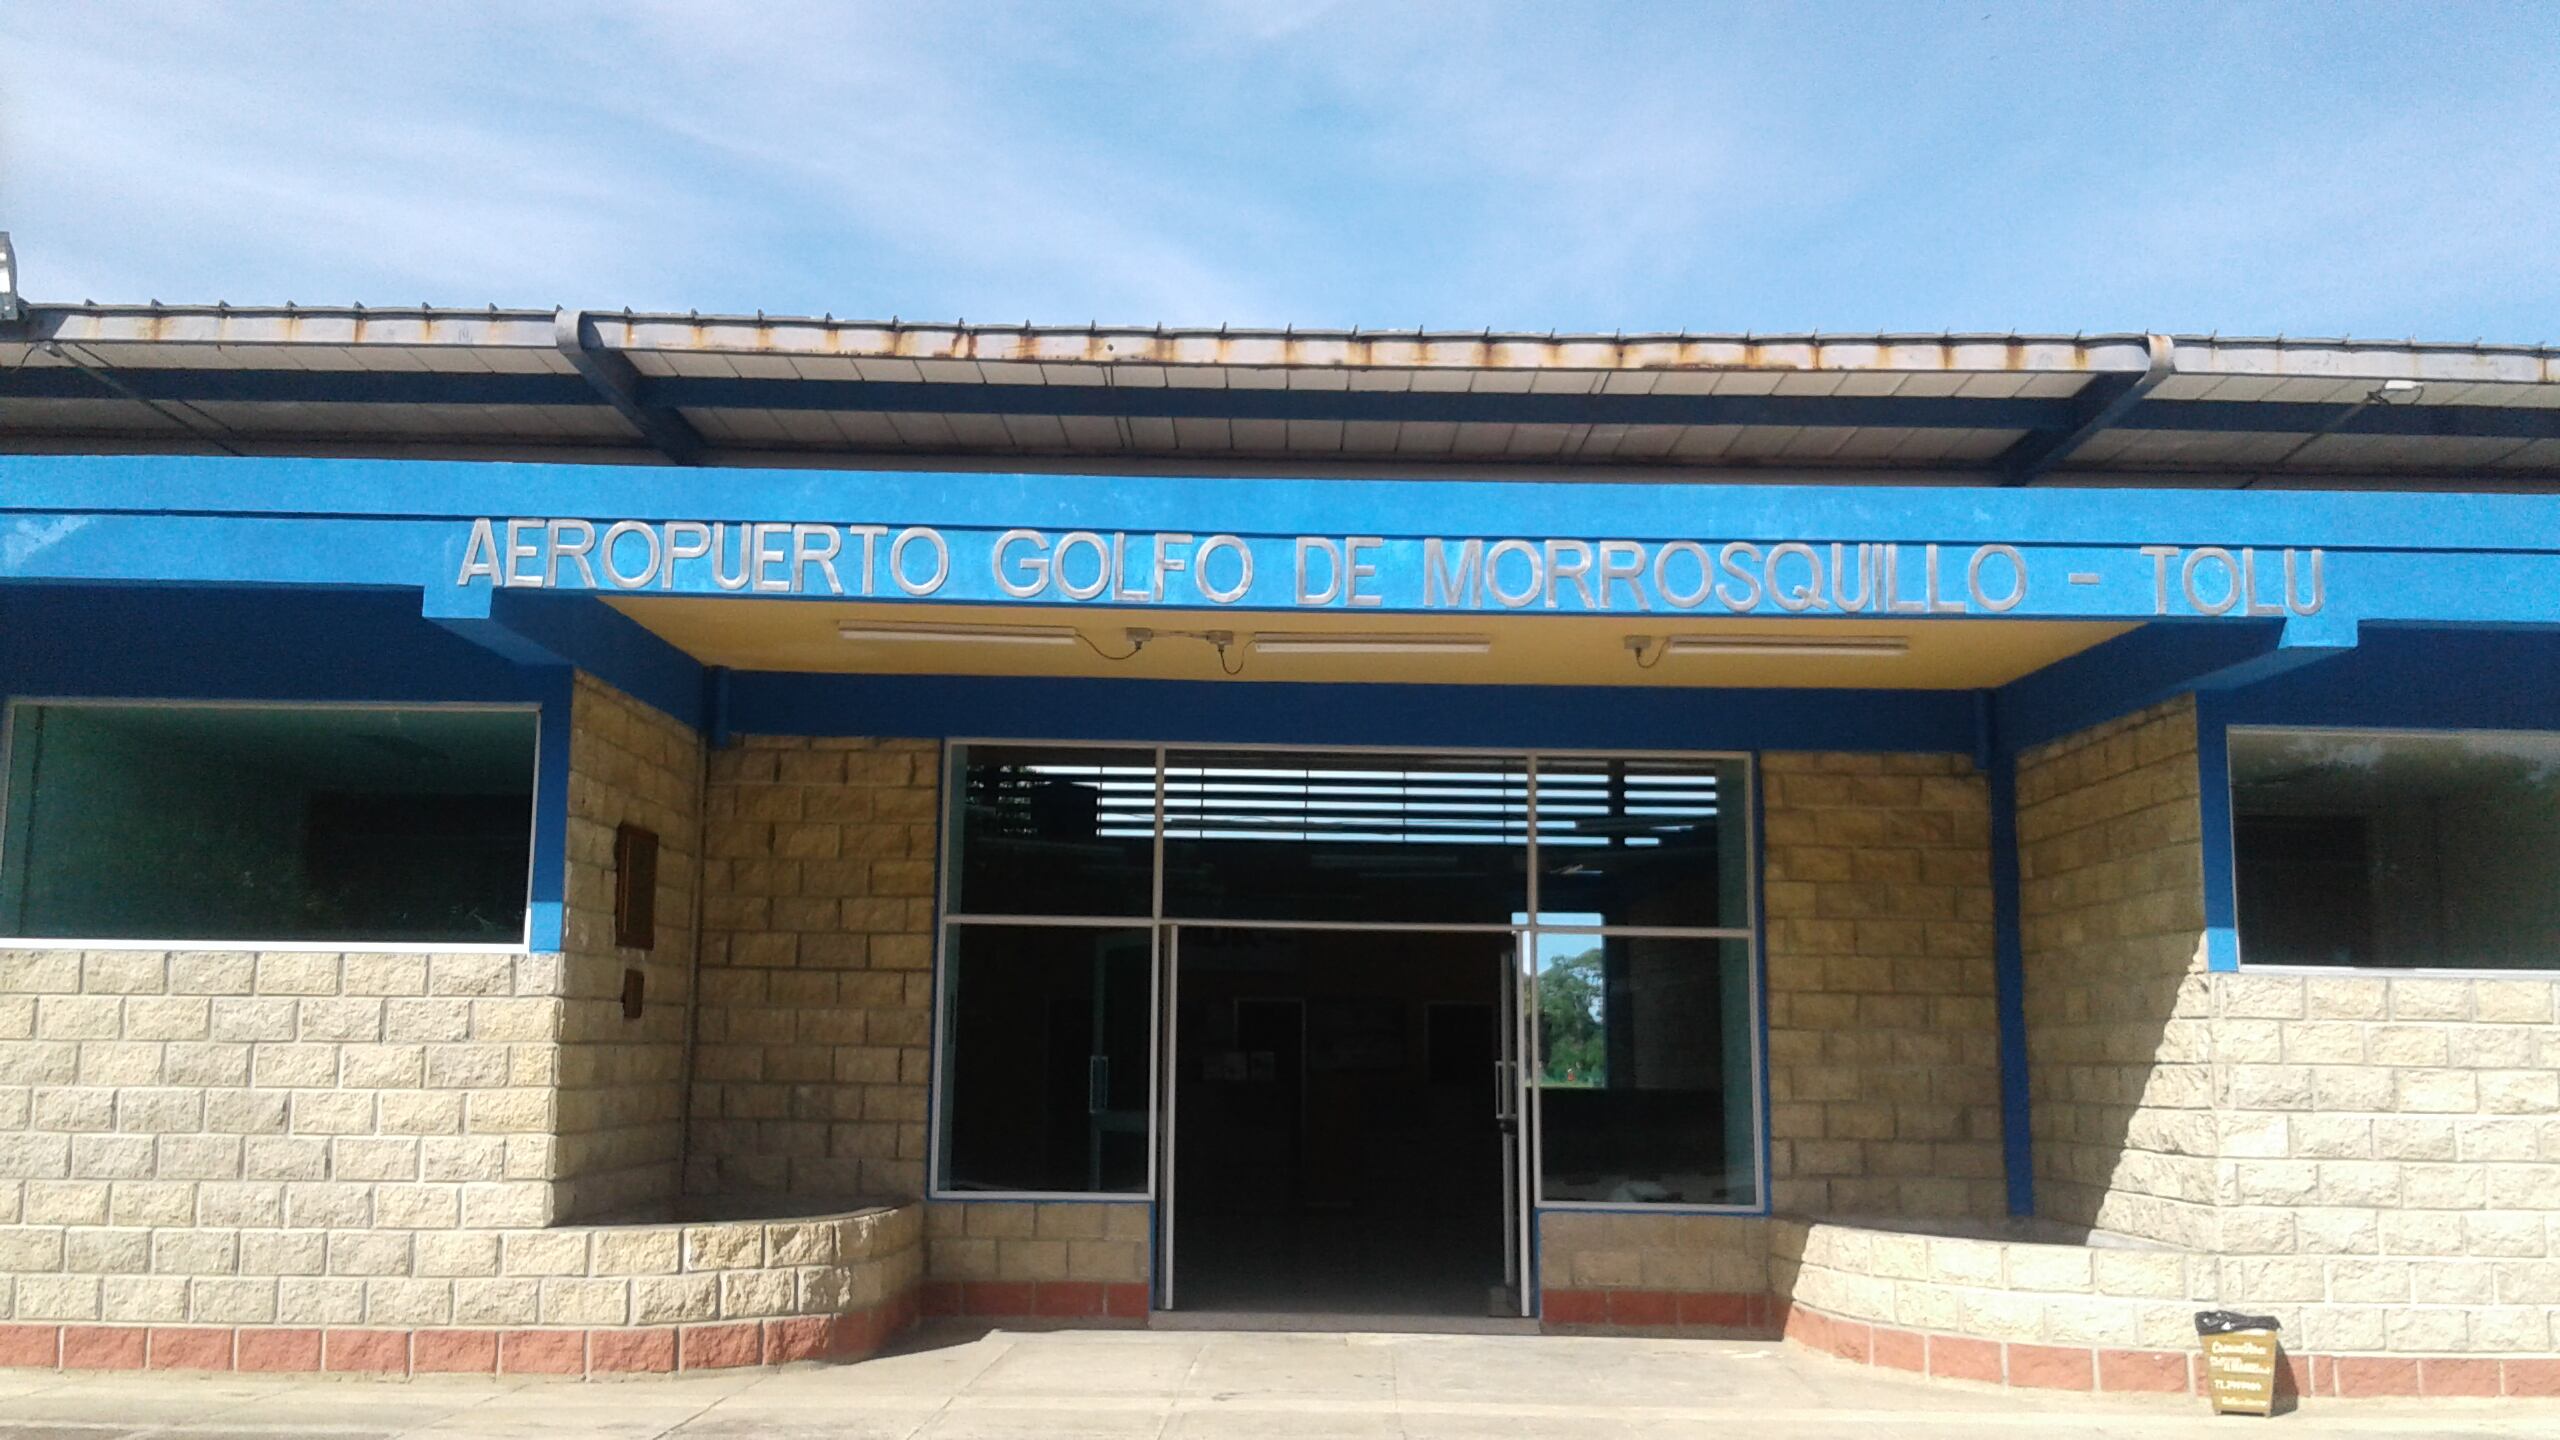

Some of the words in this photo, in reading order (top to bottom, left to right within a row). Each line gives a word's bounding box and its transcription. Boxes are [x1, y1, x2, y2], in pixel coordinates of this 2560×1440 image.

[457, 518, 950, 597] AEROPUERTO
[991, 529, 1254, 604] GOLFO
[1295, 536, 1384, 607] DE
[1423, 538, 2027, 613] MORROSQUILLO
[2068, 572, 2100, 585] -
[2140, 546, 2325, 616] TOLU
